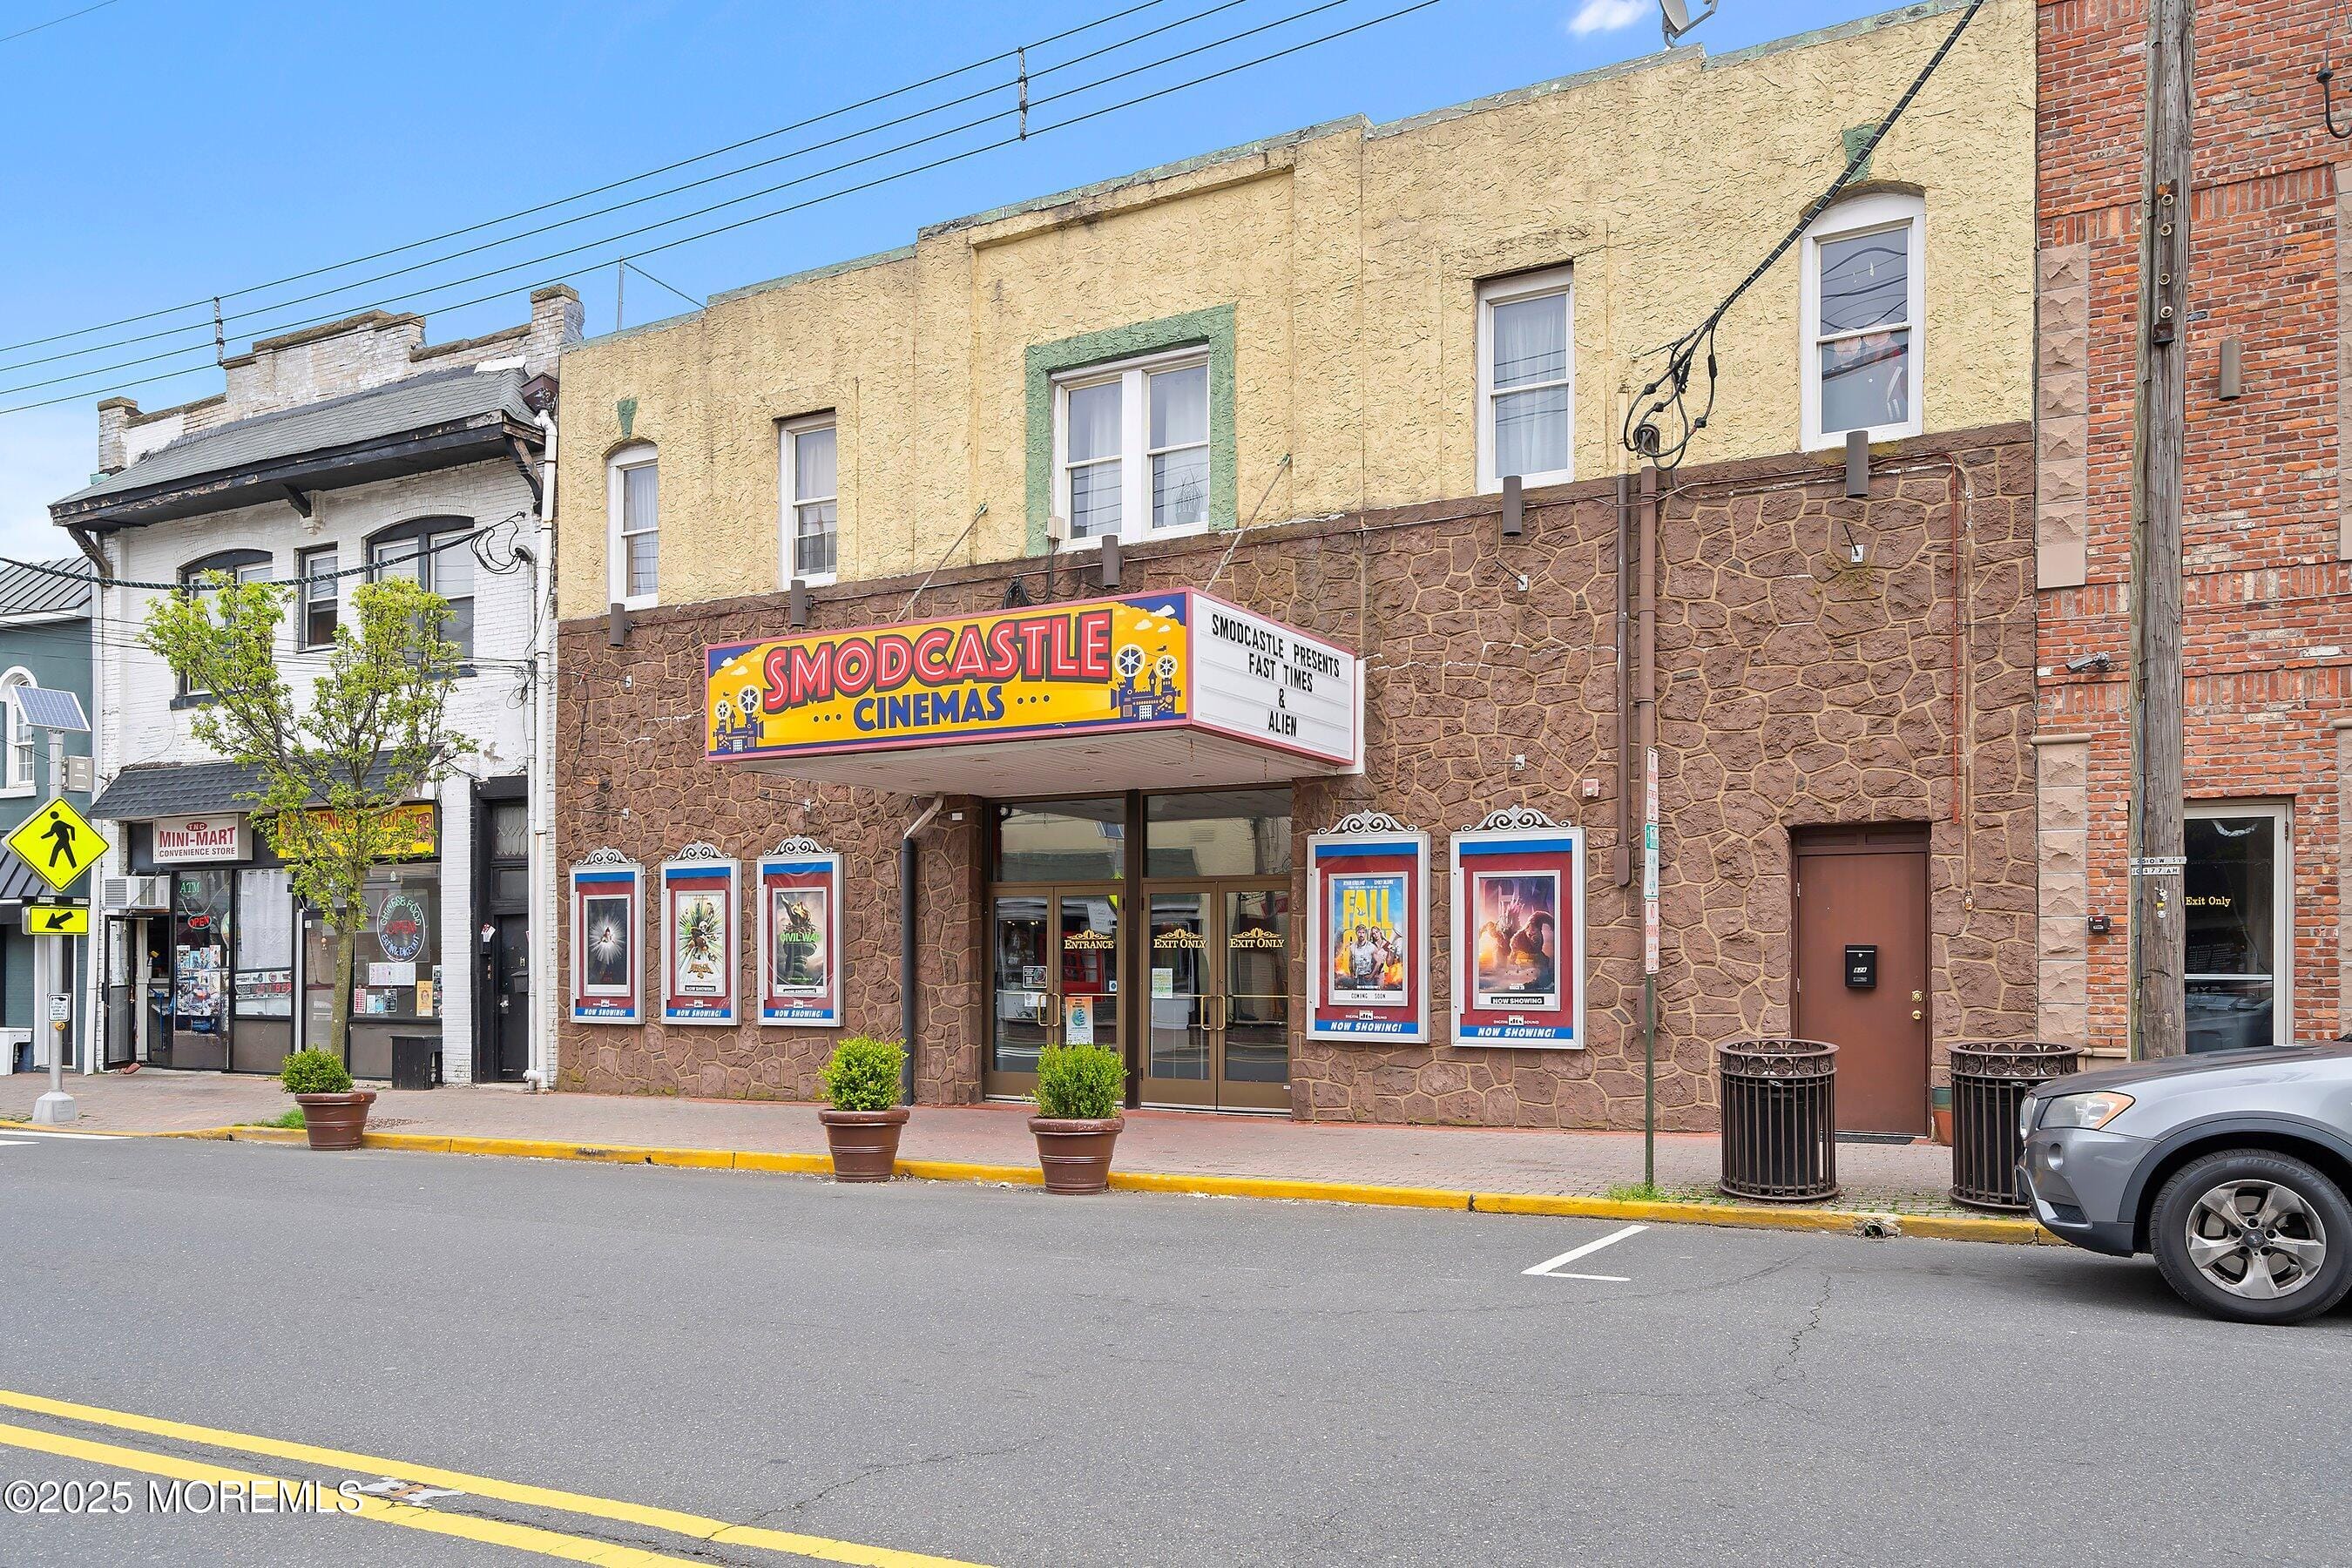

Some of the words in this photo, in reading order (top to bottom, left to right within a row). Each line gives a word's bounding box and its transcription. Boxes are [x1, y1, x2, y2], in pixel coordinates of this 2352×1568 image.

[1212, 613, 1284, 659] SMODCASTLE
[1294, 643, 1340, 678] PRESENTS
[763, 610, 1113, 714] SMODCASTLE
[1249, 653, 1276, 680] FAST
[1284, 665, 1313, 693] TIMES
[853, 685, 1004, 731] CINEMAS
[1279, 688, 1285, 708] &
[1268, 711, 1297, 737] ALIEN
[159, 827, 236, 847] MINI-MART
[159, 848, 210, 857] CONVENIENCE
[180, 882, 199, 892] ATM
[1342, 889, 1393, 929] FALL
[2186, 896, 2206, 905] Exit
[2208, 896, 2231, 907] Only
[189, 916, 209, 928] OPEN
[407, 900, 422, 926] FOOD
[387, 920, 416, 935] OPEN
[781, 933, 801, 942] CIVIL
[802, 933, 821, 942] WAR
[1330, 1022, 1352, 1031] NOW
[1355, 1022, 1402, 1032] SHOWING!
[1477, 1027, 1500, 1036] NOW
[1504, 1028, 1556, 1037] SHOWING!
